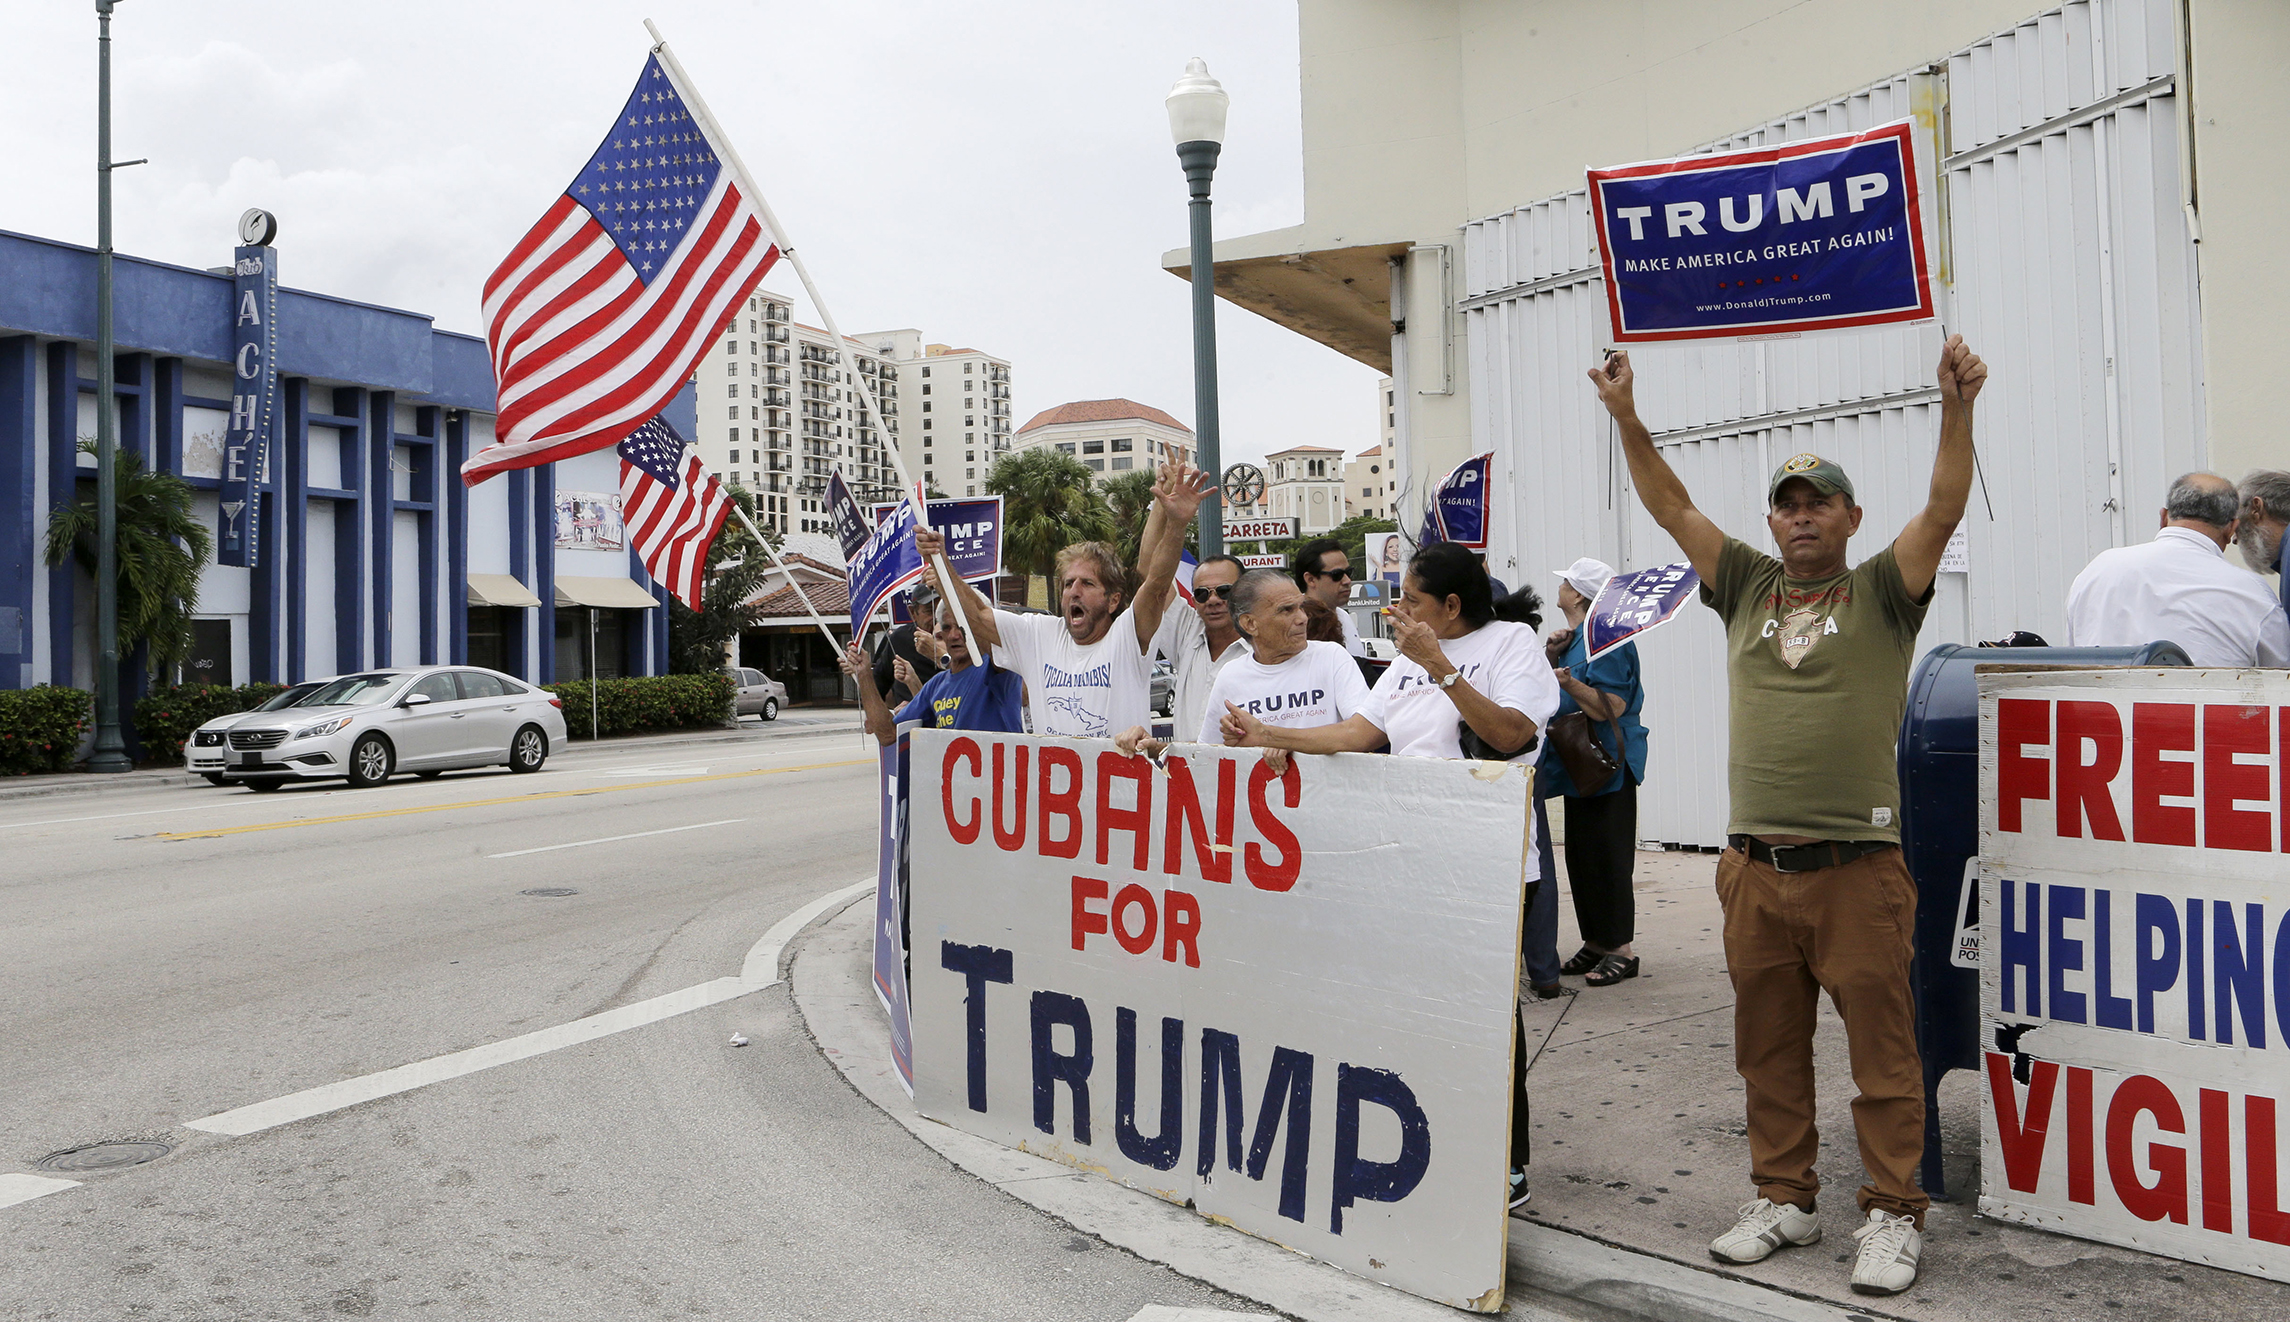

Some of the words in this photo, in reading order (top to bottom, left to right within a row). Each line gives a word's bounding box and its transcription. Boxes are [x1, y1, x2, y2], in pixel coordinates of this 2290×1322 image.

[1617, 172, 1890, 241] TRUMP
[1625, 257, 1671, 272] MAKE
[1676, 249, 1758, 270] AMERICA
[1763, 239, 1821, 260] GREAT
[1828, 226, 1894, 251] AGAIN!
[1696, 291, 1831, 312] www.DonaldJTrump.com
[848, 504, 912, 588] TRUMP
[890, 529, 914, 549] AGAIN!
[948, 552, 963, 561] REAT
[1222, 522, 1289, 538] CARRETA
[1243, 557, 1281, 567] URANT
[1347, 599, 1380, 607] BankUnited
[1635, 561, 1692, 625] TRUMP
[1280, 710, 1303, 721] GREAT
[1305, 708, 1327, 717] AGAIN!
[1998, 698, 2290, 854] FREE
[941, 737, 1302, 892] CUBANS
[1071, 876, 1201, 968] FOR
[2000, 880, 2290, 1050] HELPIN
[941, 939, 1431, 1237] TRUMP
[1985, 1052, 2290, 1247] VIGIL
